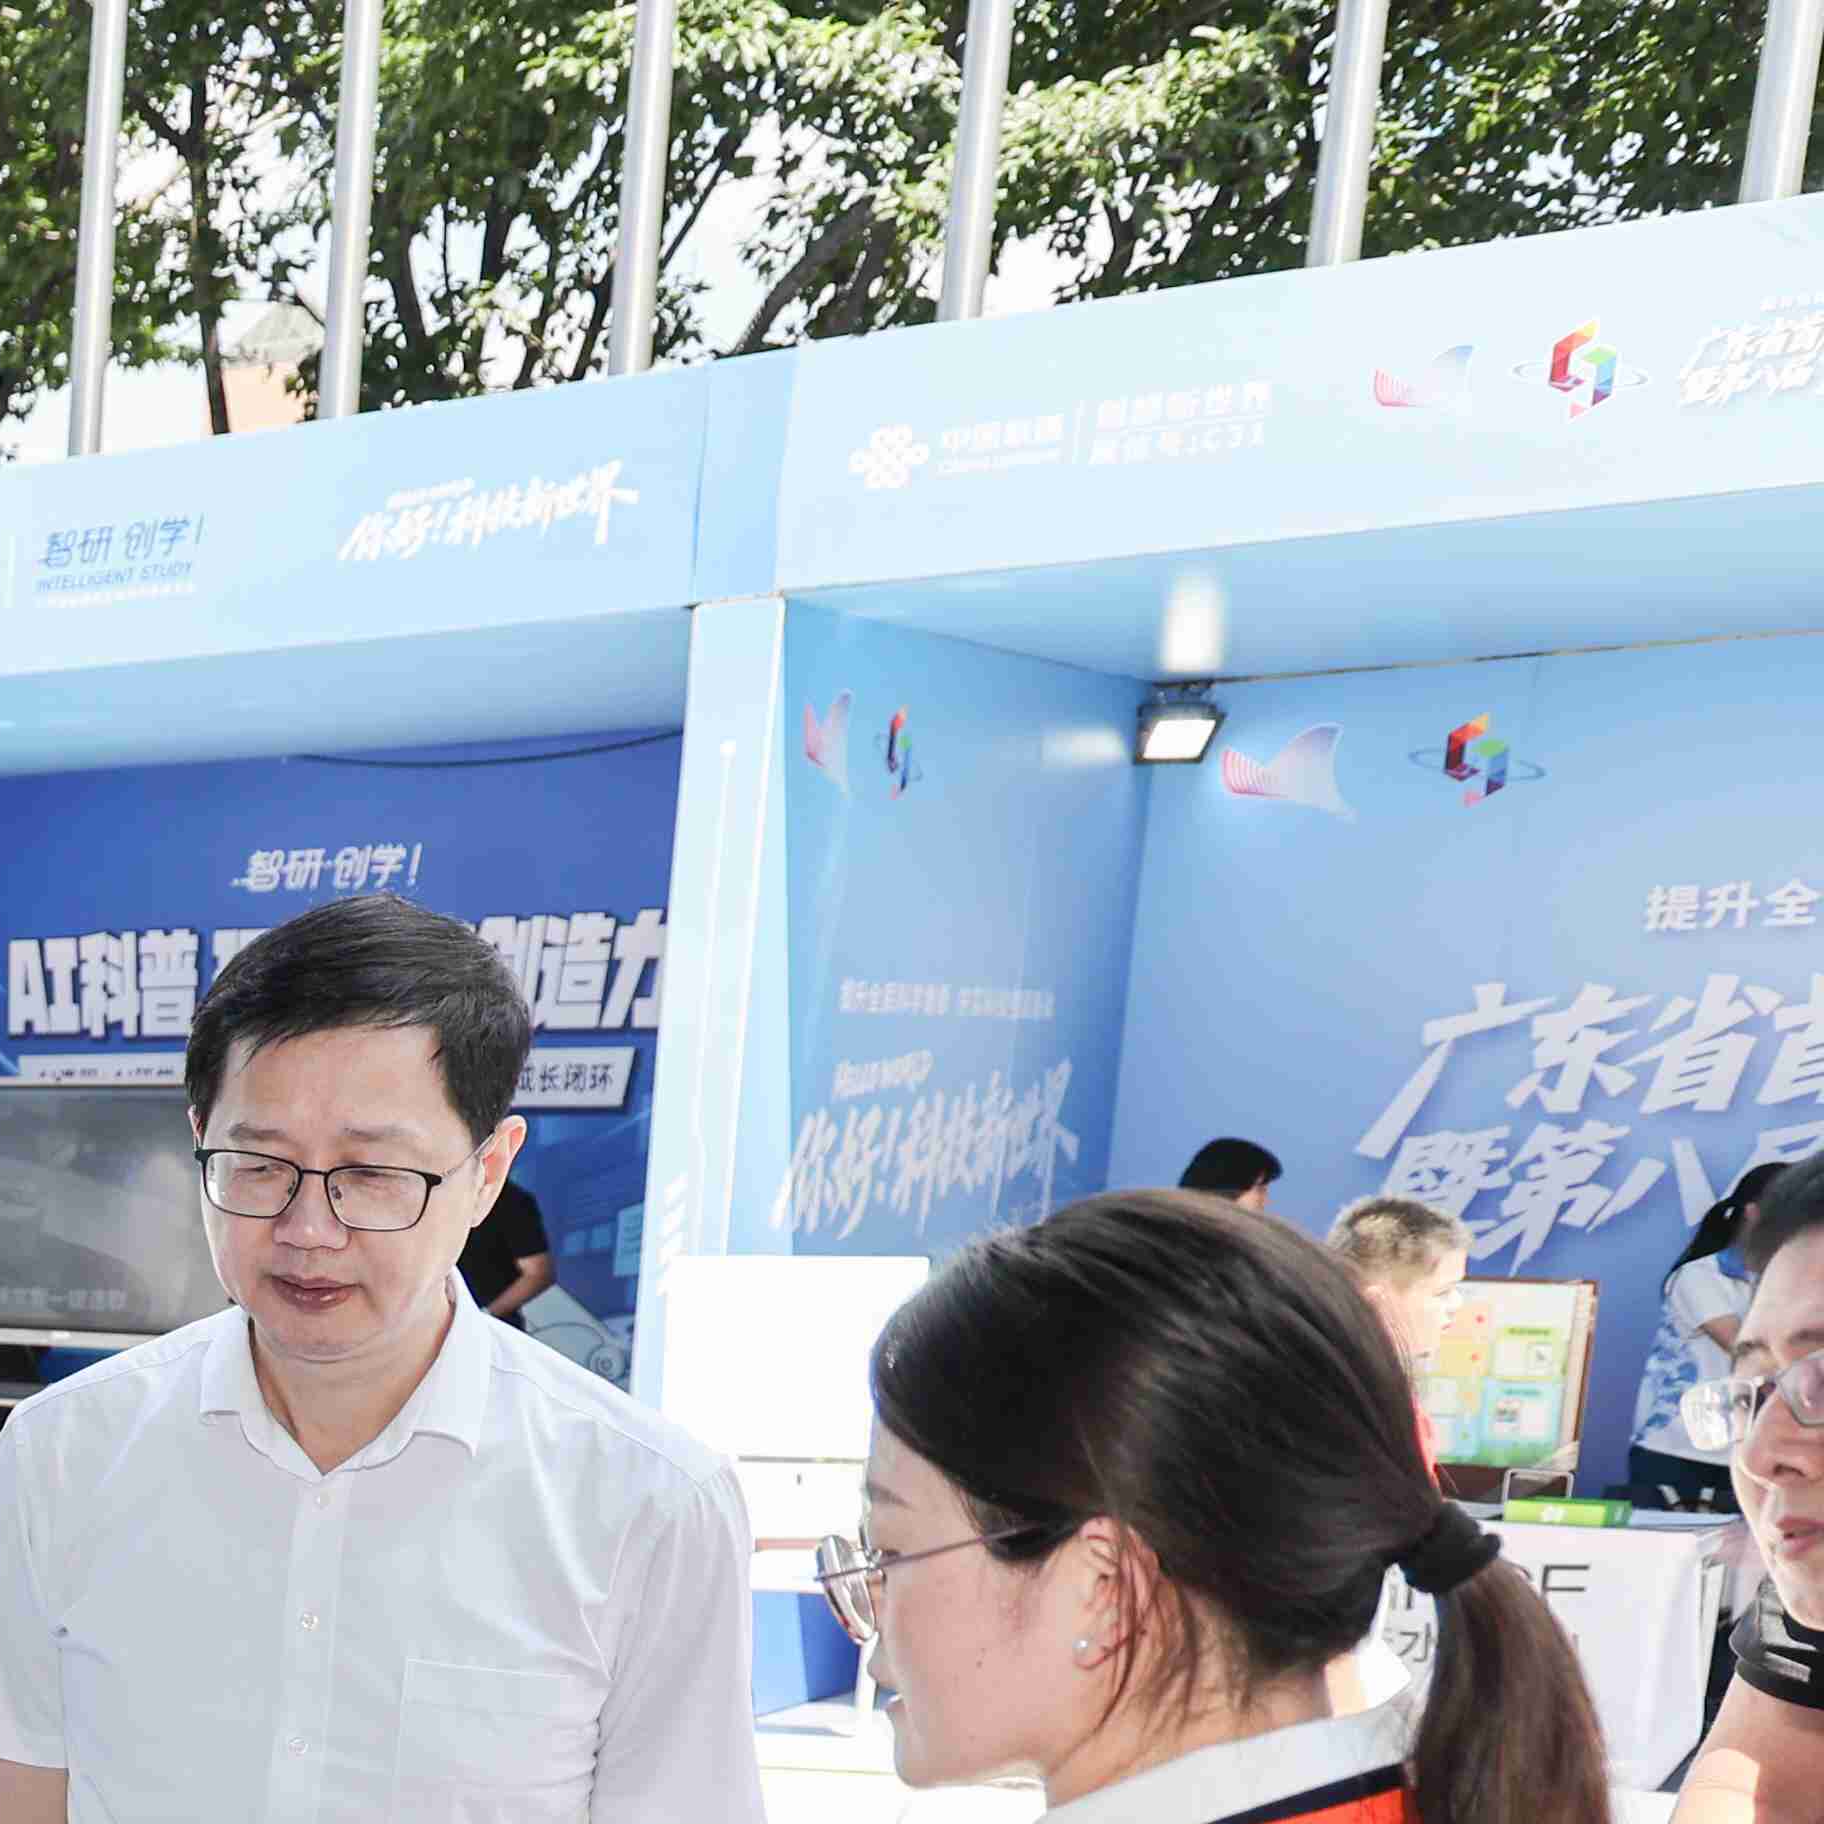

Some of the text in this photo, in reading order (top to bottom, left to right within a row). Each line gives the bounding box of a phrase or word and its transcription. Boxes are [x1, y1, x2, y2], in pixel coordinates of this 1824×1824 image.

[140, 559, 195, 580] STUDY
[1381, 1119, 1824, 1279] 暨第八
